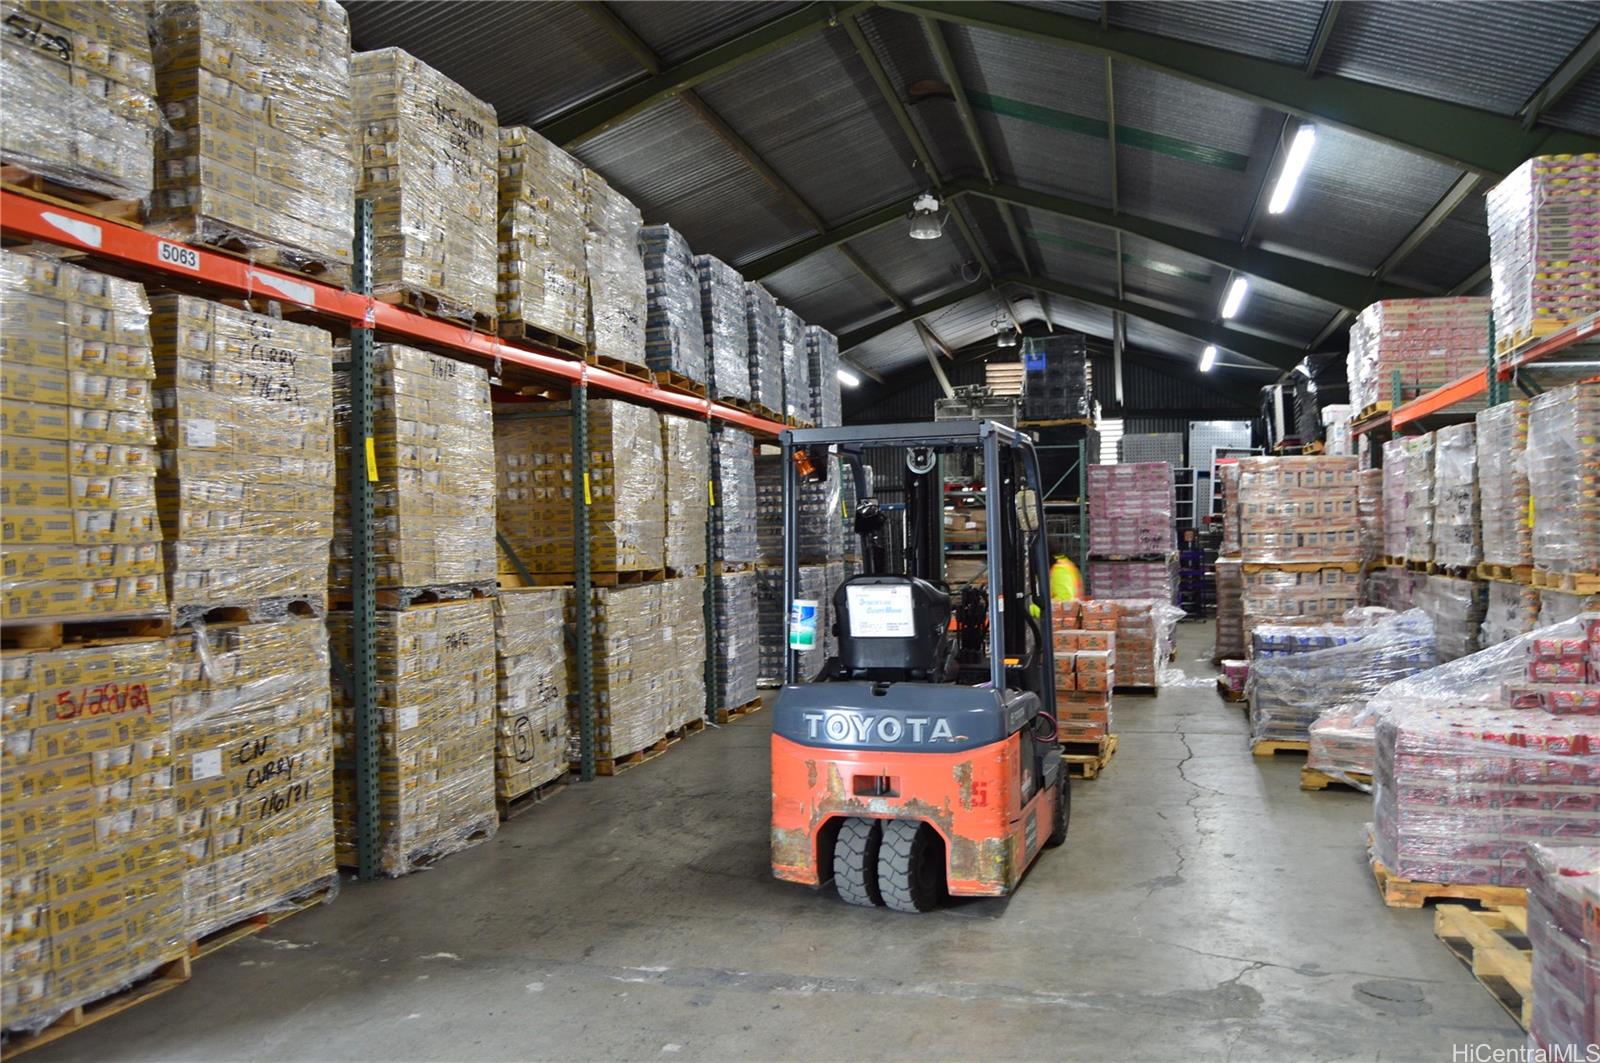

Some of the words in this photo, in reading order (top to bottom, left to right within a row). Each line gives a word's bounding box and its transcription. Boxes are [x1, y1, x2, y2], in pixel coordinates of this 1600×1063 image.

[162, 243, 197, 267] 5063
[55, 681, 152, 720] 5/28/21
[803, 713, 955, 744] TOYOTA
[246, 756, 295, 789] CURRY
